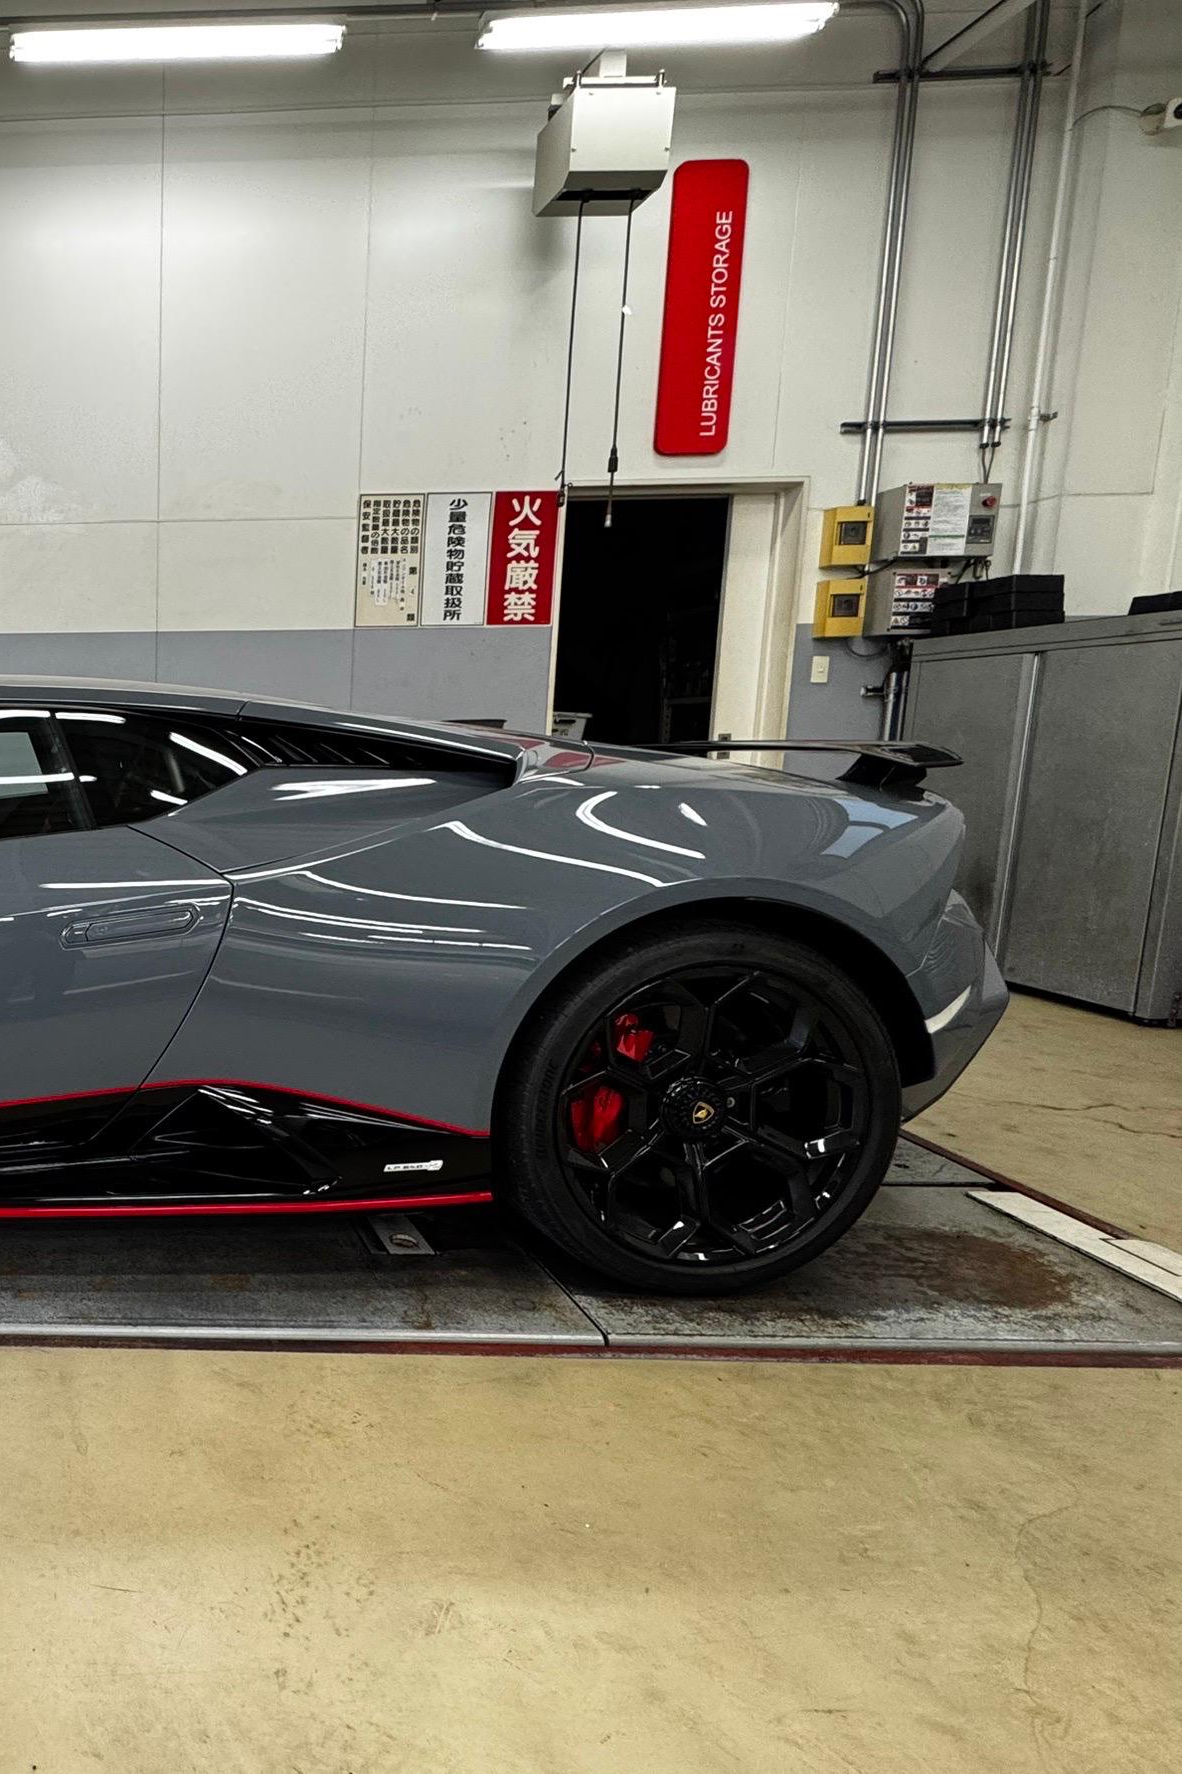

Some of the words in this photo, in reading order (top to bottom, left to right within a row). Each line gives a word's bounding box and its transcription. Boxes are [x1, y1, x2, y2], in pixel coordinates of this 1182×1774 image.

[708, 210, 733, 309] STORAGE
[699, 313, 725, 437] LUBRICANTS
[442, 498, 469, 622] 少量危険物貯蔵取扱所
[502, 495, 543, 622] 火気厳禁
